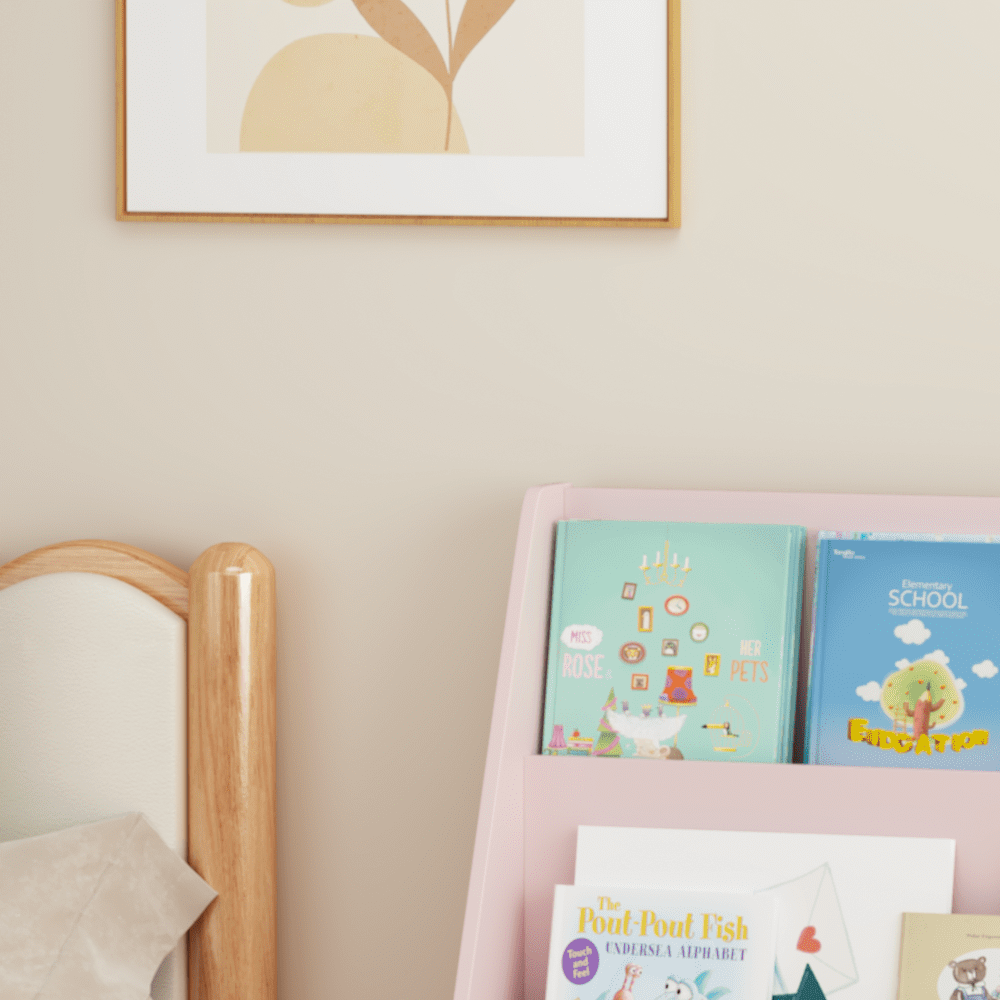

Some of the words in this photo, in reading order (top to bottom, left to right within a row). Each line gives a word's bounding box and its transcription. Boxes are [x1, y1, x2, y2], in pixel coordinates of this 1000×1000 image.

[902, 579, 953, 591] Elementary
[888, 588, 969, 610] SCHOOL
[570, 629, 593, 644] MISS
[739, 639, 762, 656] HER
[562, 652, 605, 679] ROSE
[730, 659, 769, 683] PETS
[597, 895, 621, 912] The
[576, 906, 696, 940] Pout-Pout
[700, 912, 749, 943] Fish
[567, 945, 593, 960] Touch
[605, 940, 673, 959] UNDERSEA
[675, 943, 748, 962] ALPHABET
[572, 957, 589, 969] and
[572, 966, 591, 980] Feel
